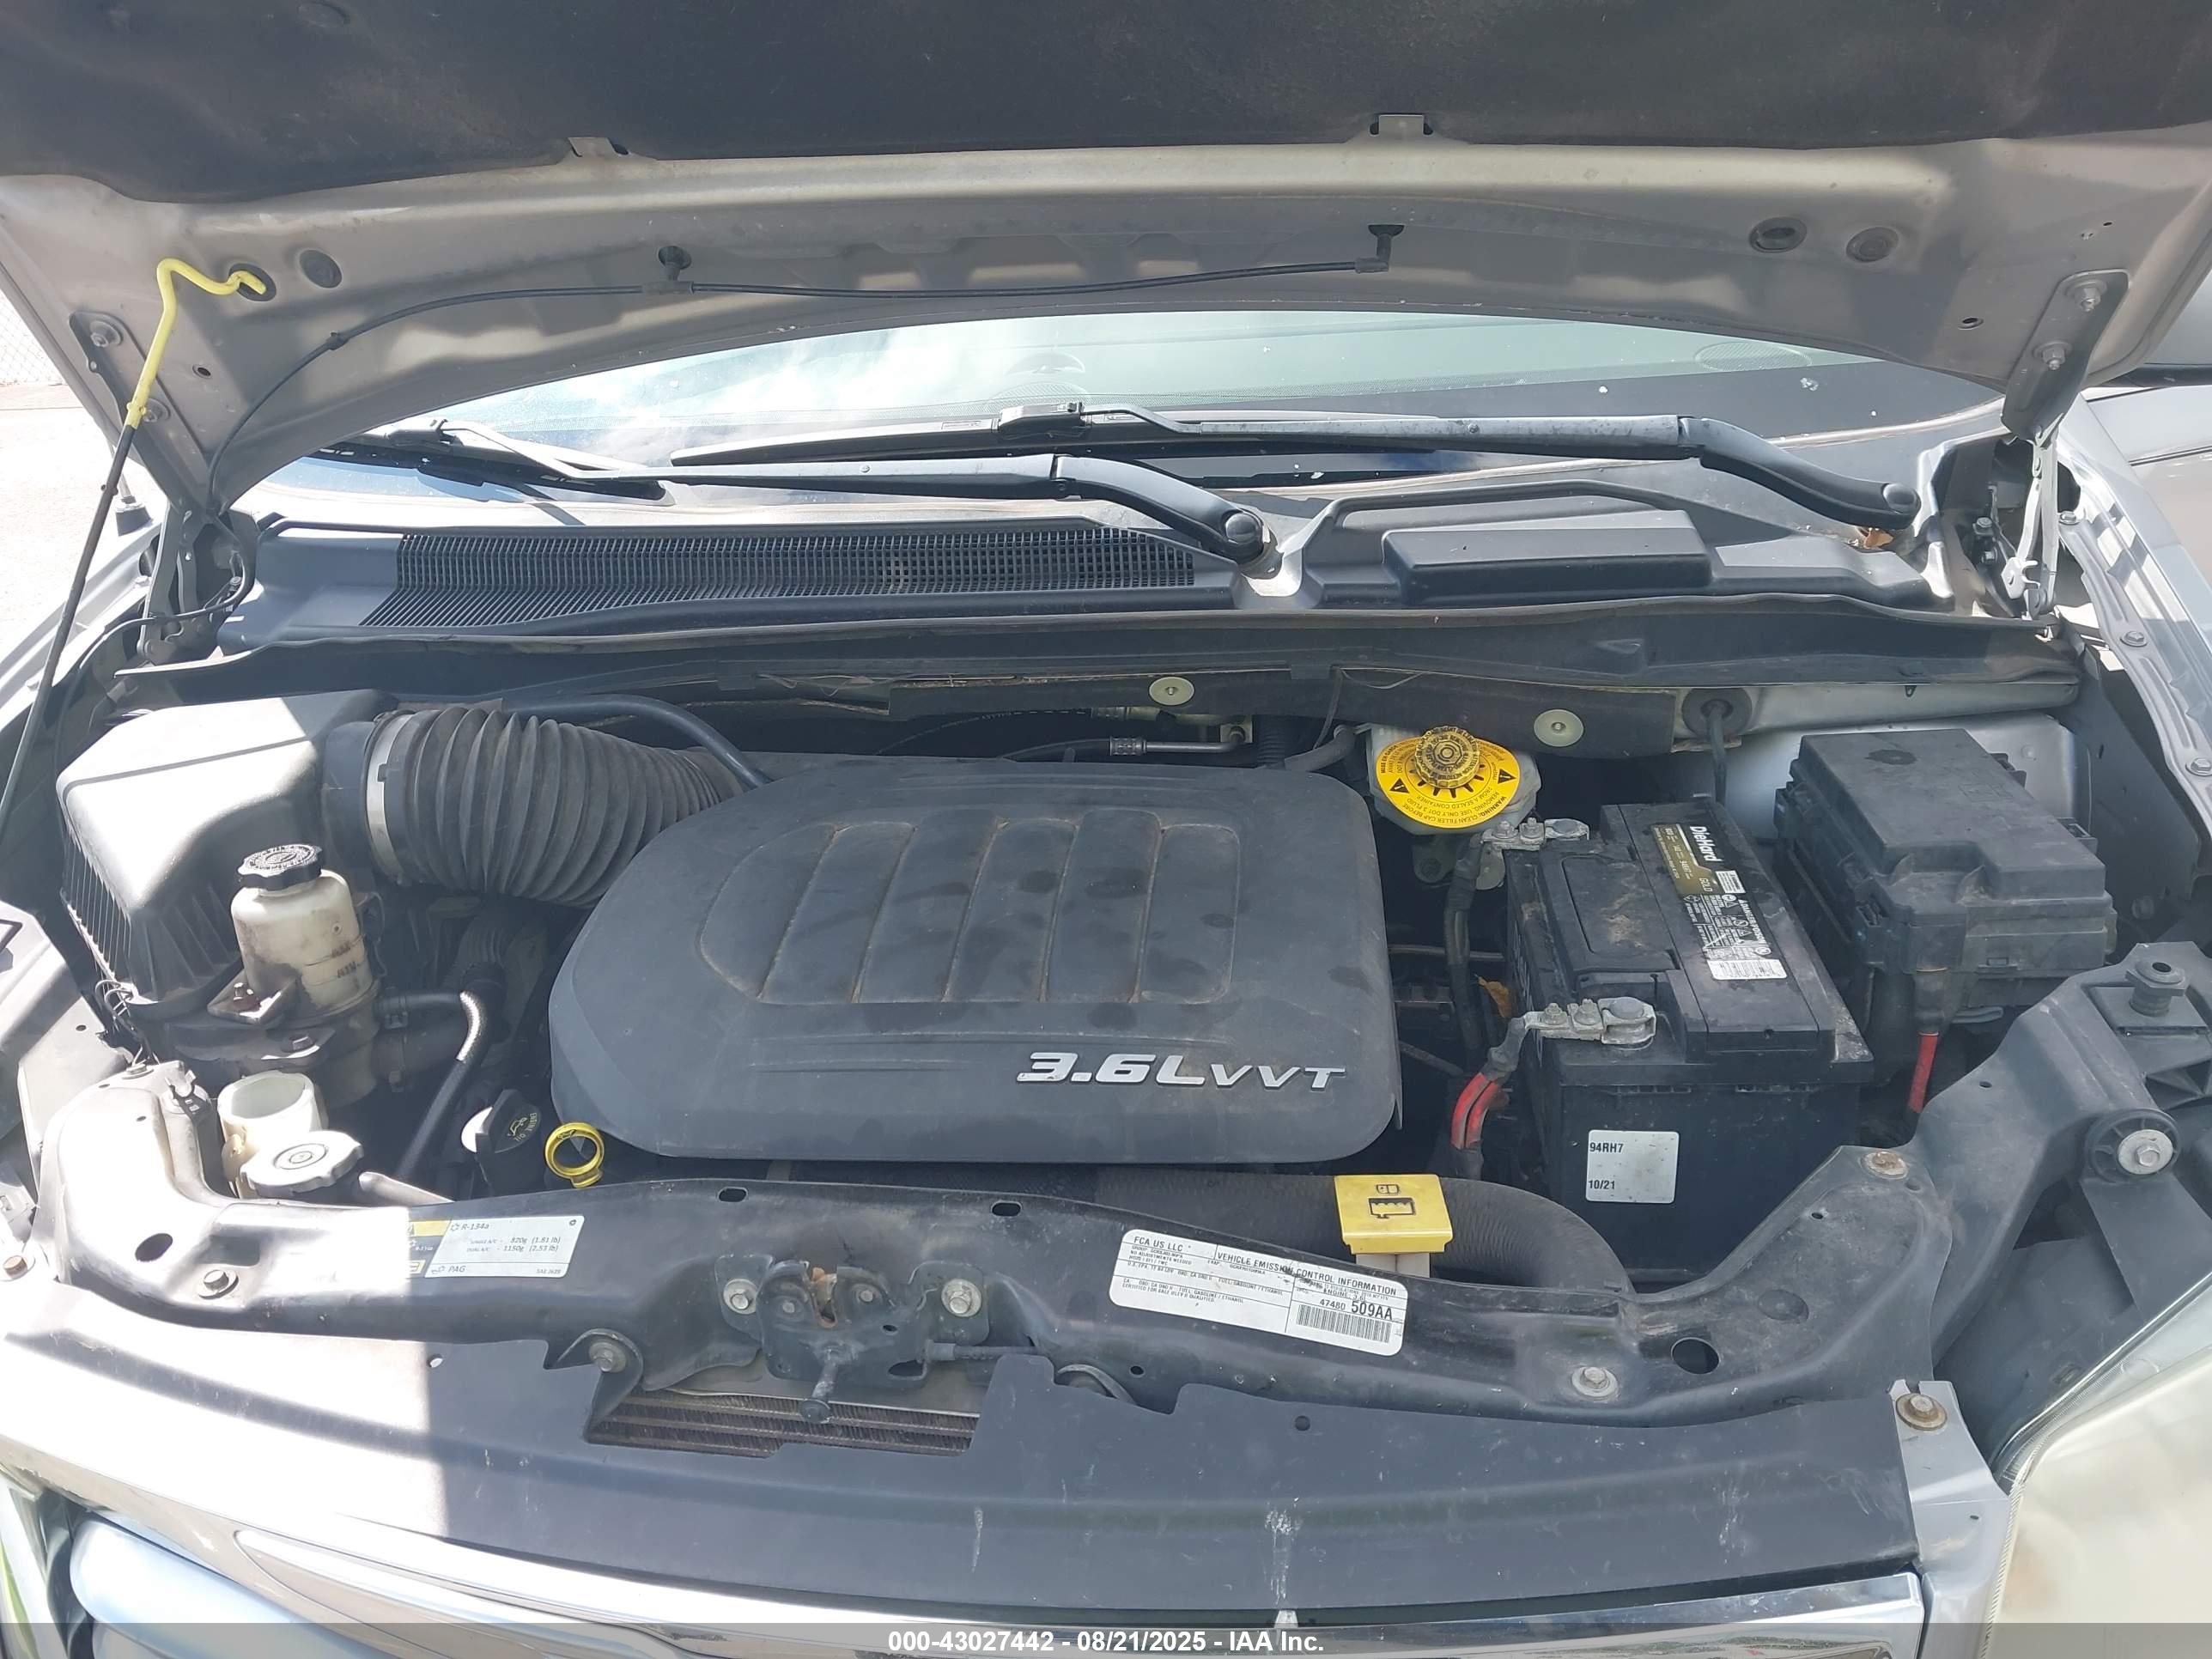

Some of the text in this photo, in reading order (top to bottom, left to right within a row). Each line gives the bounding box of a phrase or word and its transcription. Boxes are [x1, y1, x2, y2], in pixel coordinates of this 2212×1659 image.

[1478, 787, 1492, 798] FROM
[1406, 798, 1422, 808] FLUID
[1415, 795, 1449, 808] CONTAINER
[1451, 799, 1473, 808] SEALED
[1478, 796, 1506, 817] WARNING:
[1402, 802, 1422, 817] BEFORE
[1458, 813, 1477, 823] CLEAN
[1690, 826, 1722, 862] DieHard
[1699, 877, 1713, 892] GOLD
[1210, 1063, 1346, 1091] VVT
[514, 1133, 526, 1142] OIL
[1589, 1142, 1624, 1153] 94RH7
[1588, 1180, 1615, 1190] 10/21
[1134, 1236, 1183, 1252] FCA US LLC
[1218, 1253, 1251, 1265] VEHICLE
[1297, 1268, 1334, 1283] CONTROL
[1338, 1277, 1397, 1295] INFORMATION
[1320, 1299, 1392, 1320] 47480 509AA
